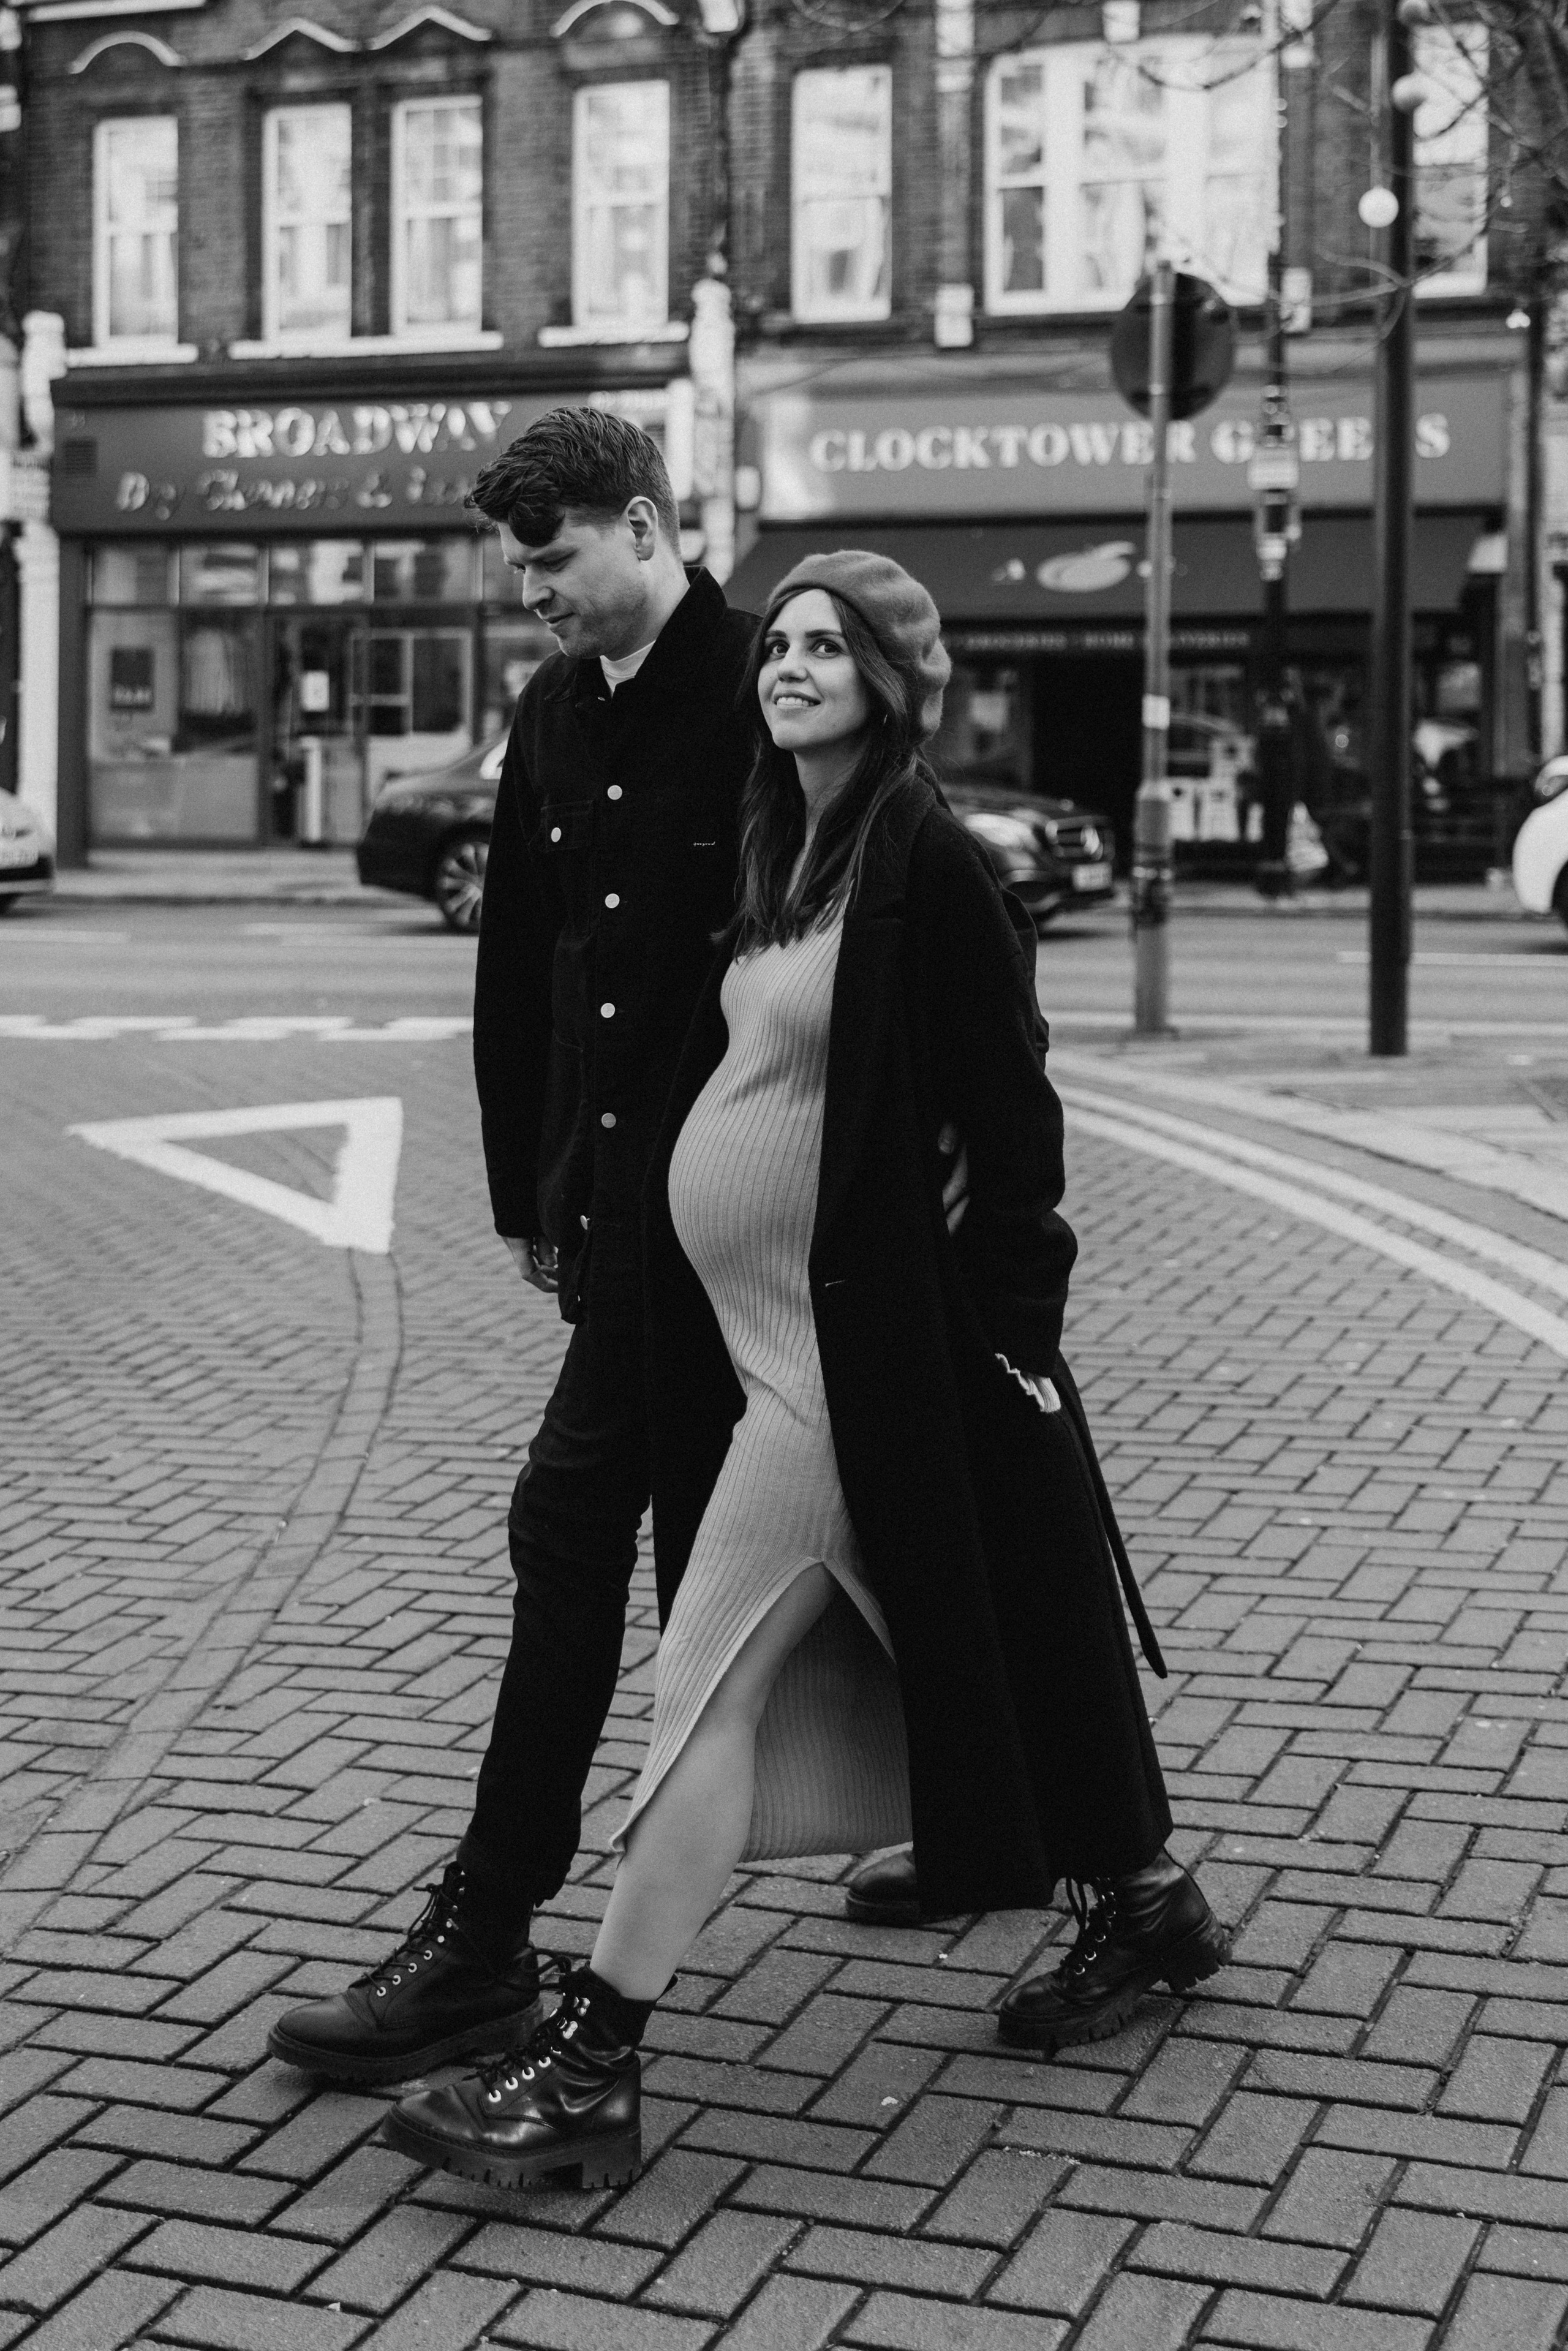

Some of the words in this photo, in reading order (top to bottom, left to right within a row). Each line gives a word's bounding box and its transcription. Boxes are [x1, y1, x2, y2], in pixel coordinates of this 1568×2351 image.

[202, 401, 513, 458] BROADWAY
[809, 420, 1197, 473] CLOCKTOWER
[1210, 413, 1450, 464] GEES
